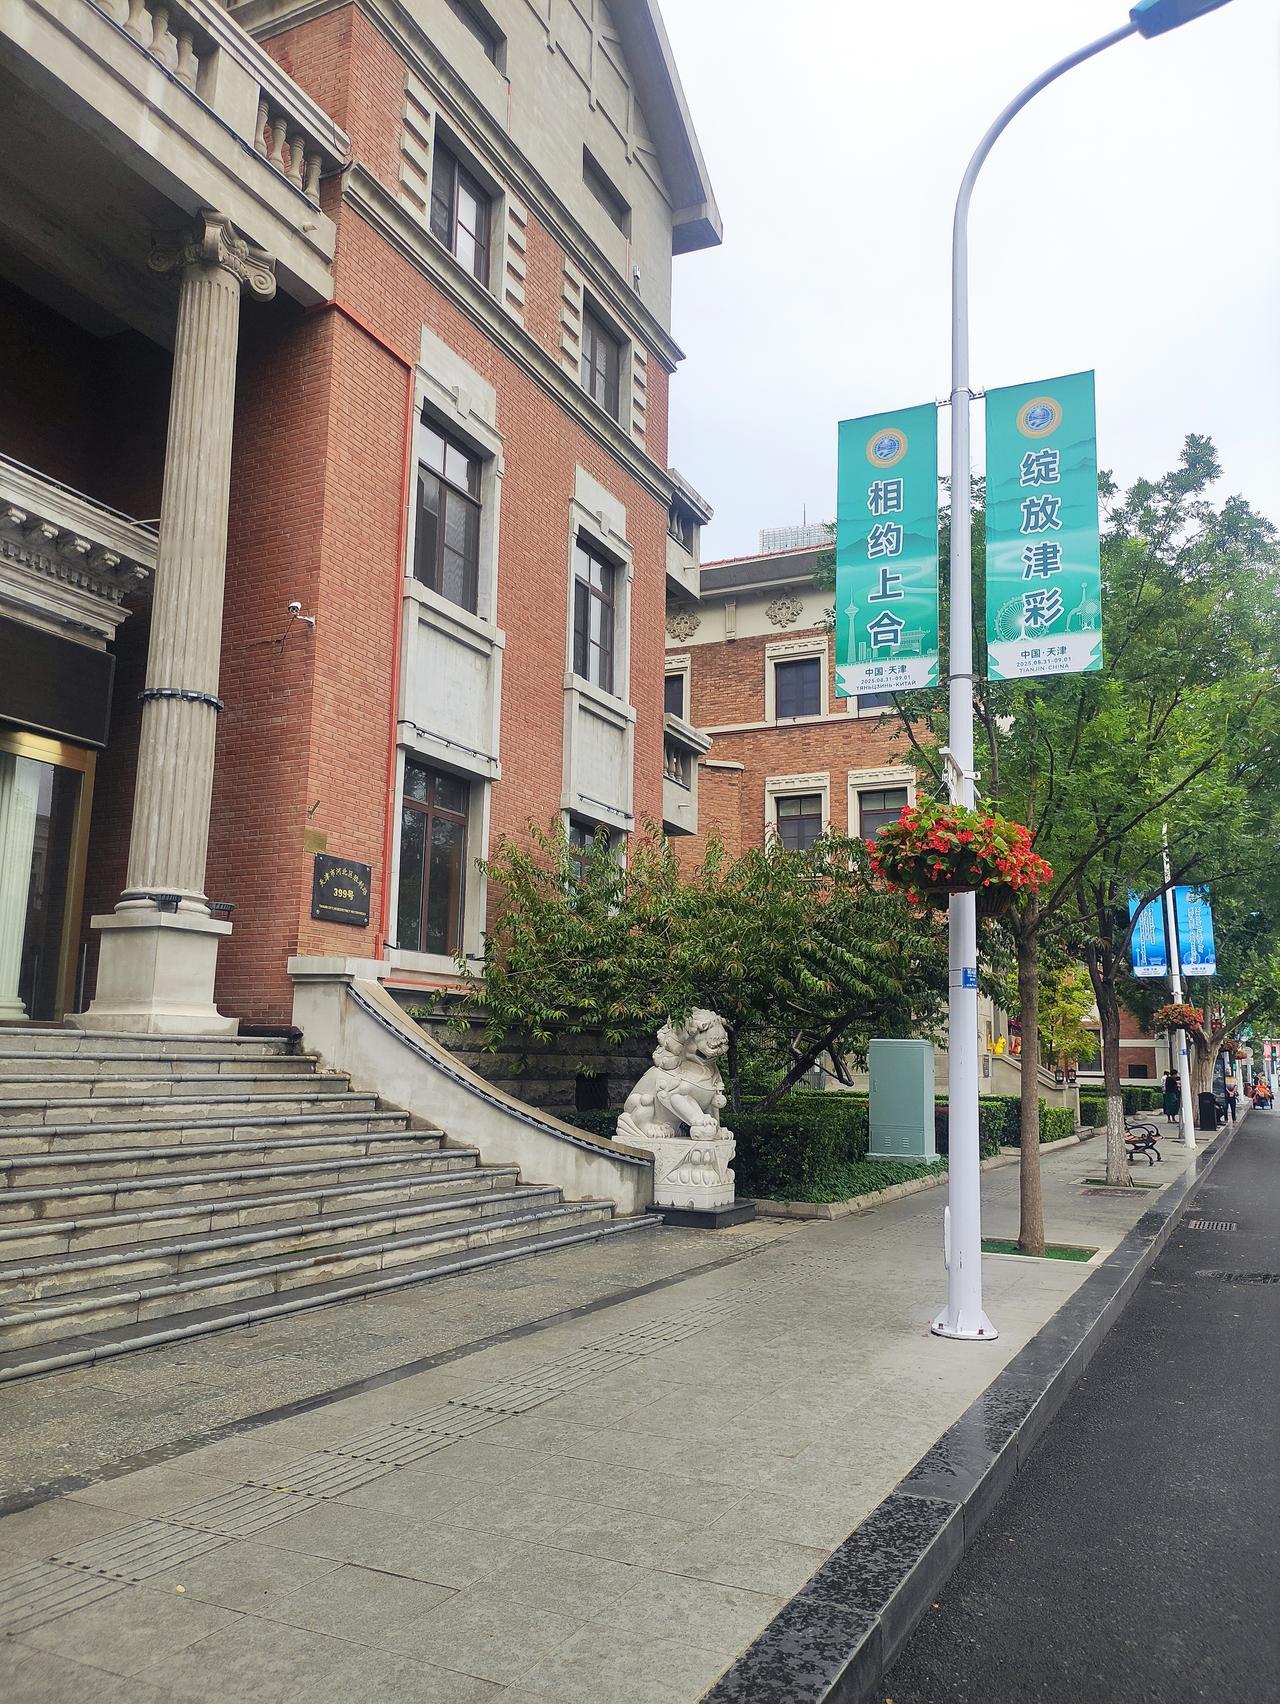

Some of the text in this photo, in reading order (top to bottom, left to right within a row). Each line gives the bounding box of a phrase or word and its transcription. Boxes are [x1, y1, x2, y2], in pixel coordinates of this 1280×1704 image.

[1019, 448, 1064, 628] 绽放津彩
[867, 477, 905, 649] 相约上合
[1021, 646, 1067, 659] 中国·天津
[865, 664, 907, 677] 中国·天津
[333, 887, 354, 901] 399号
